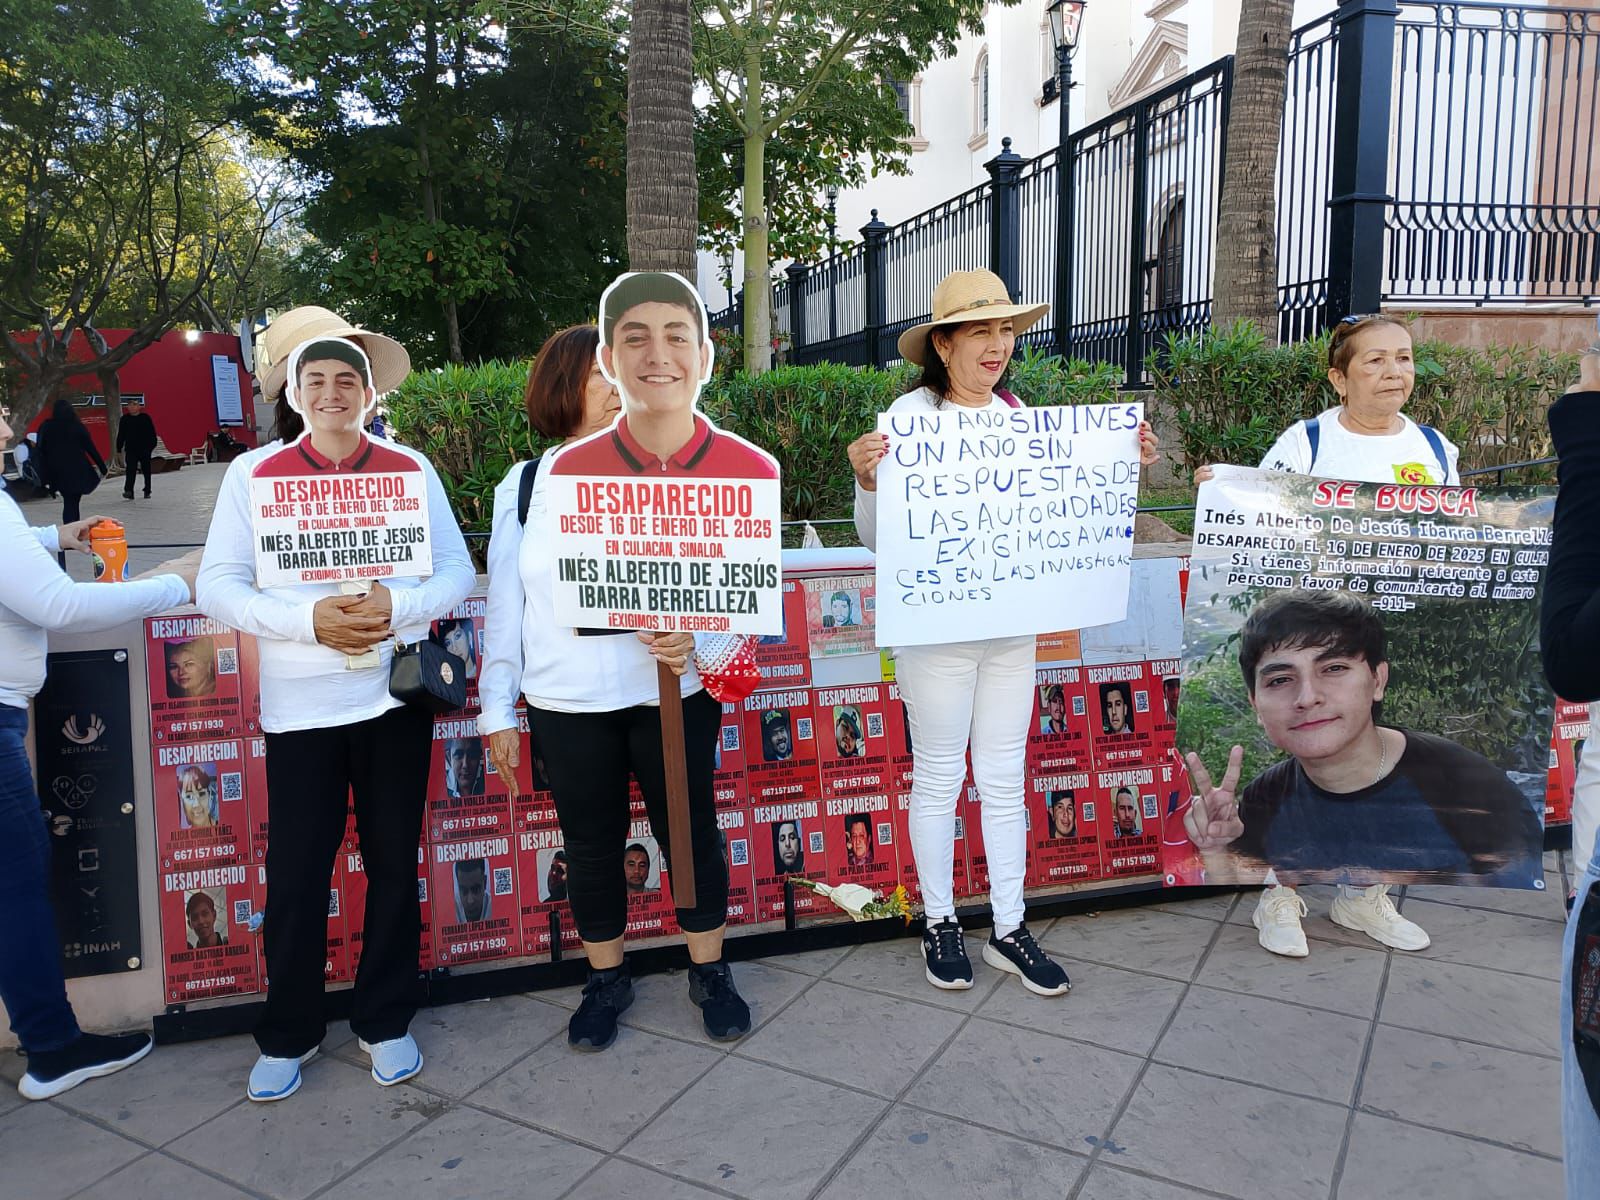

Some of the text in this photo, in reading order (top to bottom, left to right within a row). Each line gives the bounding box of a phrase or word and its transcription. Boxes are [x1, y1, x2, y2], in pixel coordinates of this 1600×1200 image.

[892, 405, 1138, 436] UN AÑO SIN INES
[895, 441, 944, 467] UN
[958, 434, 1015, 461] AÑO
[274, 477, 405, 503] DESAPARECIDO
[906, 460, 1140, 502] RESPUESTAS DE
[262, 498, 420, 518] DESDE 16 DE ENERO DEL 2025
[576, 482, 753, 517] DESAPARECIDO
[1313, 481, 1479, 517] SE BUSCA
[298, 519, 309, 530] EN
[560, 515, 772, 539] DESDE 16 DE ENERO DEL 2025
[908, 508, 969, 540] LAS
[1203, 508, 1246, 526] Inés
[1255, 511, 1322, 532] Alberto
[1332, 516, 1353, 534] De
[1361, 518, 1411, 538] Jesús
[1419, 521, 1481, 542] Ibarra
[261, 523, 425, 553] INÉS ALBERTO DE JESÚS
[606, 540, 619, 555] EN
[680, 542, 726, 558] SINALOA.
[278, 545, 413, 570] IBARRA BERRELLEZA
[1302, 539, 1320, 553] EL
[1327, 540, 1346, 554] 16
[1353, 542, 1371, 556] DE
[1378, 544, 1420, 559] ENERO
[1428, 546, 1446, 560] DE
[1453, 548, 1486, 562] 2025
[1491, 550, 1510, 564] EN
[345, 568, 354, 578] TU
[558, 552, 777, 589] INÉS ALBERTO DE JESÚS
[896, 569, 941, 589] CES
[955, 566, 982, 584] EN
[992, 559, 1036, 583] LAS
[1231, 553, 1540, 583] Si tienes información referente a esta
[808, 578, 874, 593] DESAPARECIDO
[1227, 571, 1536, 599] persona favor de comunicarte al número
[579, 585, 758, 614] IBARRA BERRELLEZA
[902, 587, 992, 606] CIONES
[662, 615, 676, 630] TU
[680, 615, 731, 632] REGRESO!
[1089, 665, 1142, 684] DESAPARECIDO
[744, 691, 809, 711] DESAPARECIDO
[819, 687, 879, 707] DESAPARECIDO
[171, 722, 187, 733] 667
[159, 746, 239, 767] DESAPARECIDA
[1034, 773, 1089, 792] DESAPARECIDO
[1098, 768, 1153, 788] DESAPARECIDO
[754, 801, 818, 823] DESAPARECIDO
[826, 795, 889, 817] DESAPARECIDO
[443, 815, 498, 831] 667 157 1930
[174, 844, 235, 861] 667 157 1930
[437, 838, 509, 862] DESAPARECIDO
[165, 866, 246, 892] DESAPARECIDO
[83, 940, 121, 955] INAH
[451, 938, 507, 954] 667 157 1930
